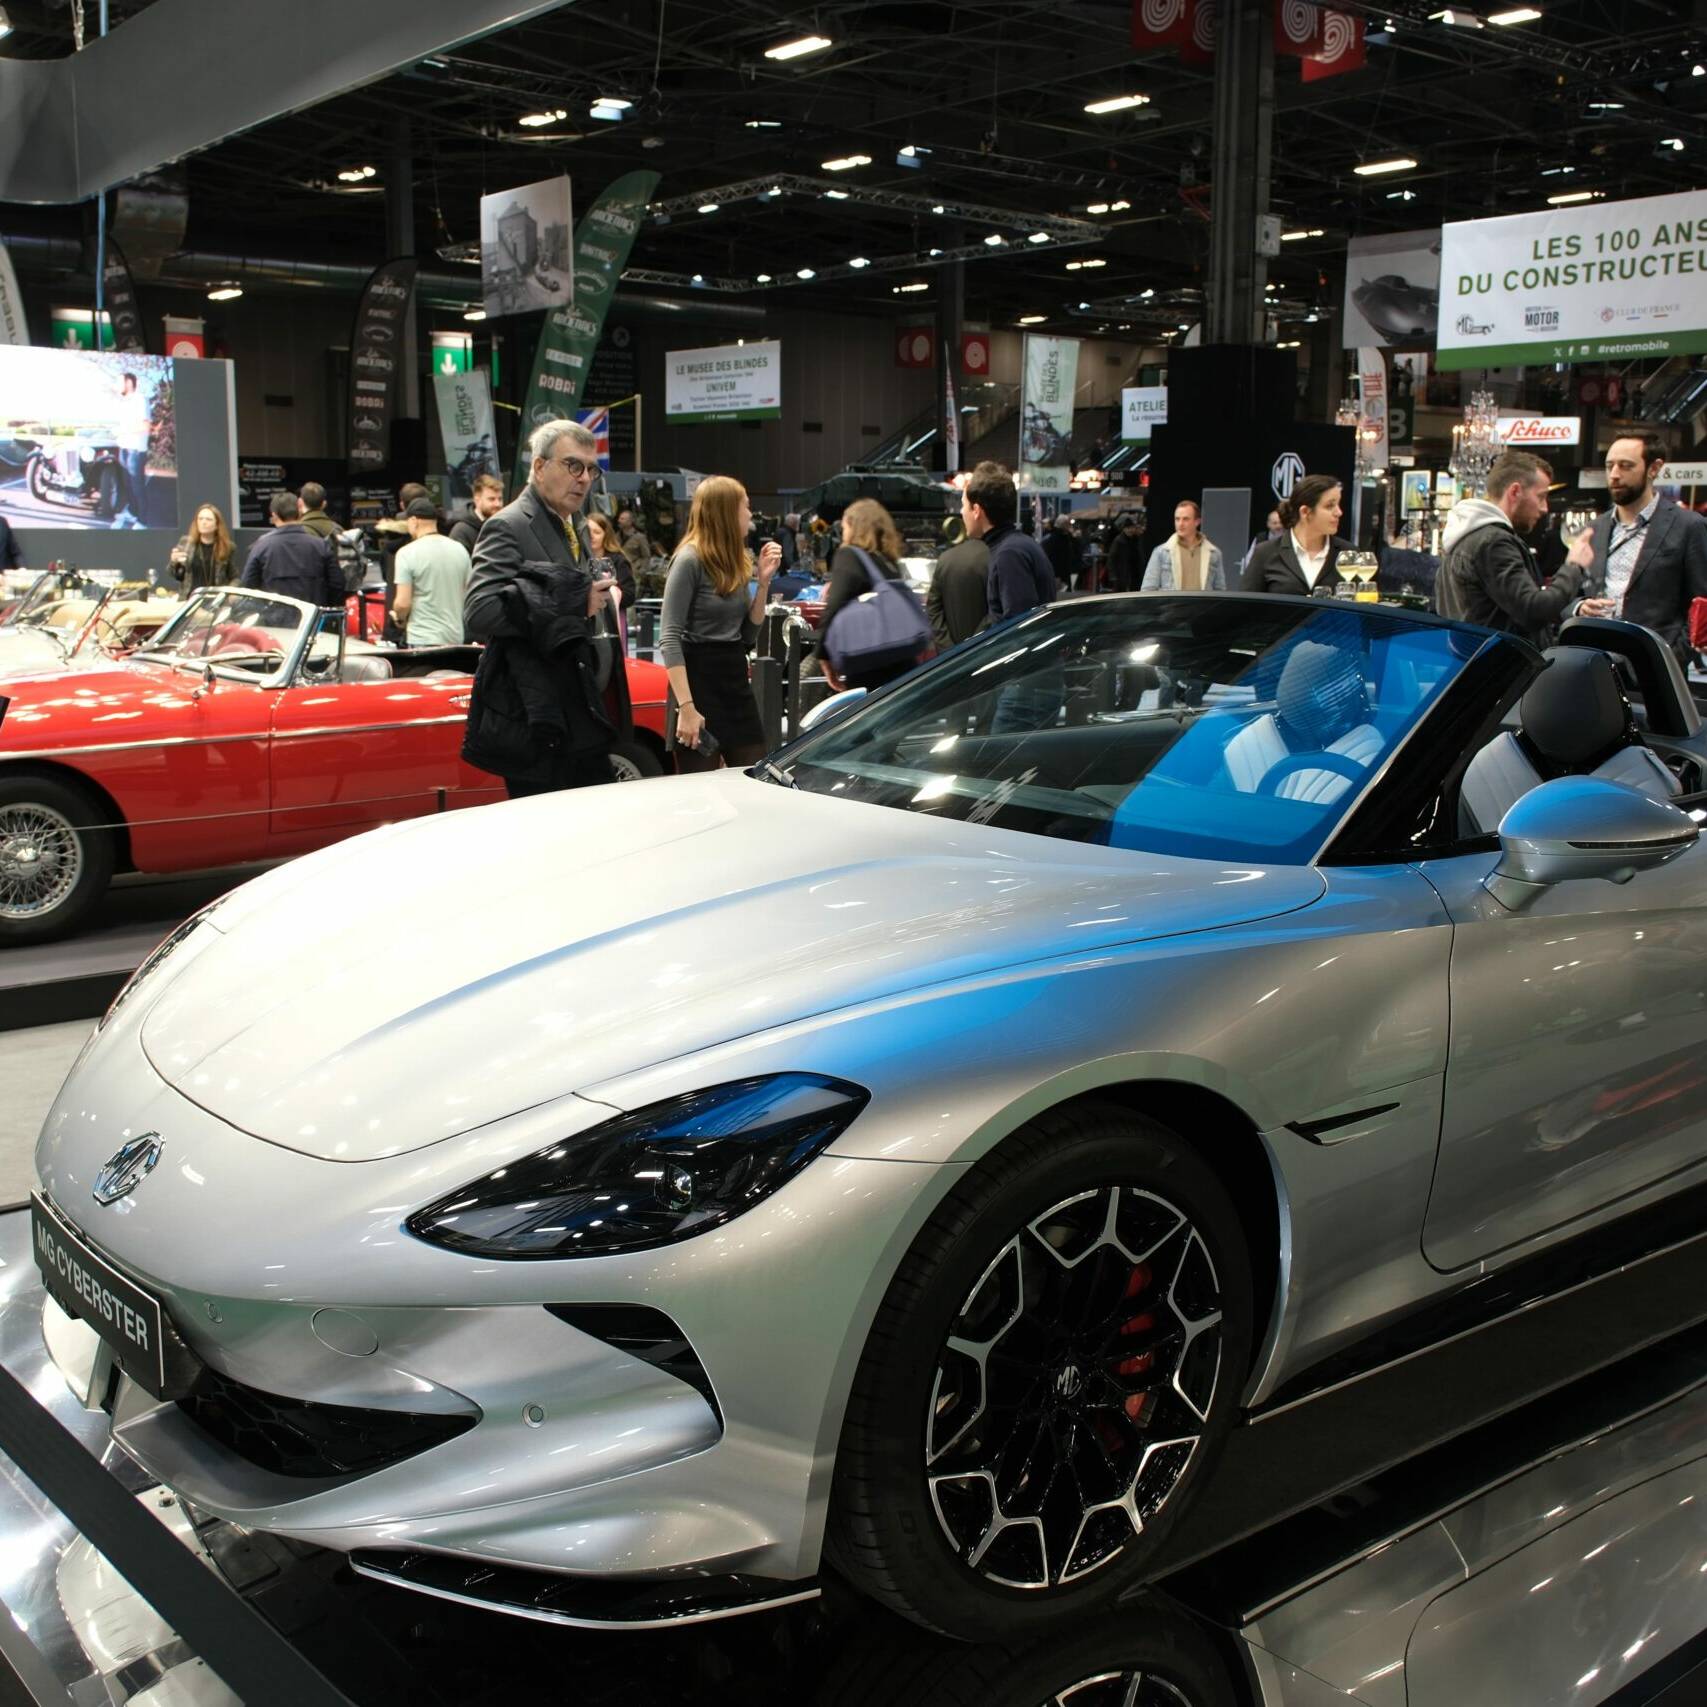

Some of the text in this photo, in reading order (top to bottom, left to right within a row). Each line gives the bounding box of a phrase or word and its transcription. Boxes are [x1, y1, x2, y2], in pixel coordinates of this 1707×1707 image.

[1532, 218, 1707, 260] LES 100 ANS
[1458, 273, 1492, 295] DU
[1524, 311, 1559, 326] MOTOR
[1598, 339, 1669, 353] #retromobile
[676, 365, 685, 375] LE
[716, 360, 731, 372] DES
[706, 381, 736, 393] UNIVEM
[1501, 419, 1572, 441] Schuco
[1675, 470, 1703, 480] cars
[37, 1220, 149, 1350] MG CYBERSTER
